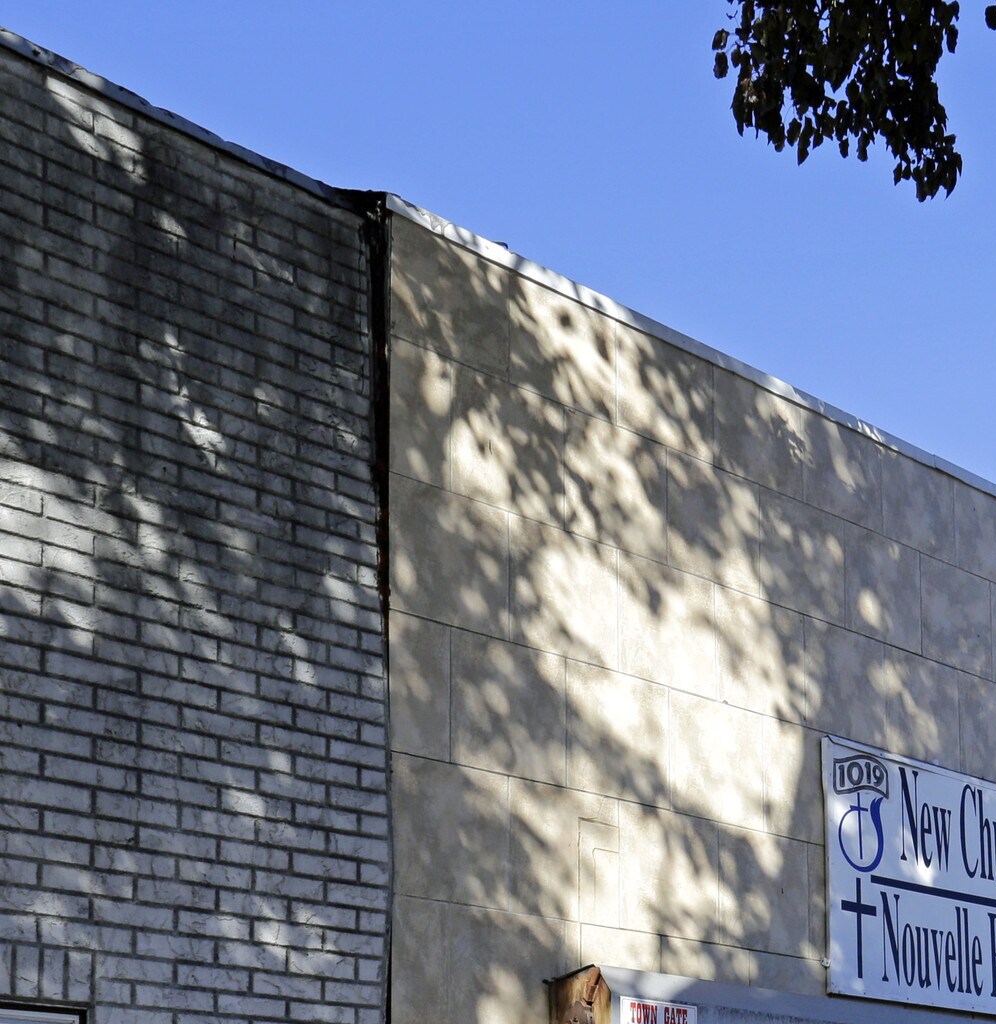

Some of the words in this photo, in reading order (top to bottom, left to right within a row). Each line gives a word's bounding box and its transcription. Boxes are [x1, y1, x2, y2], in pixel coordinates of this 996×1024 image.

[838, 761, 885, 787] 1019
[898, 766, 952, 873] New
[879, 890, 985, 997] Nouvelle
